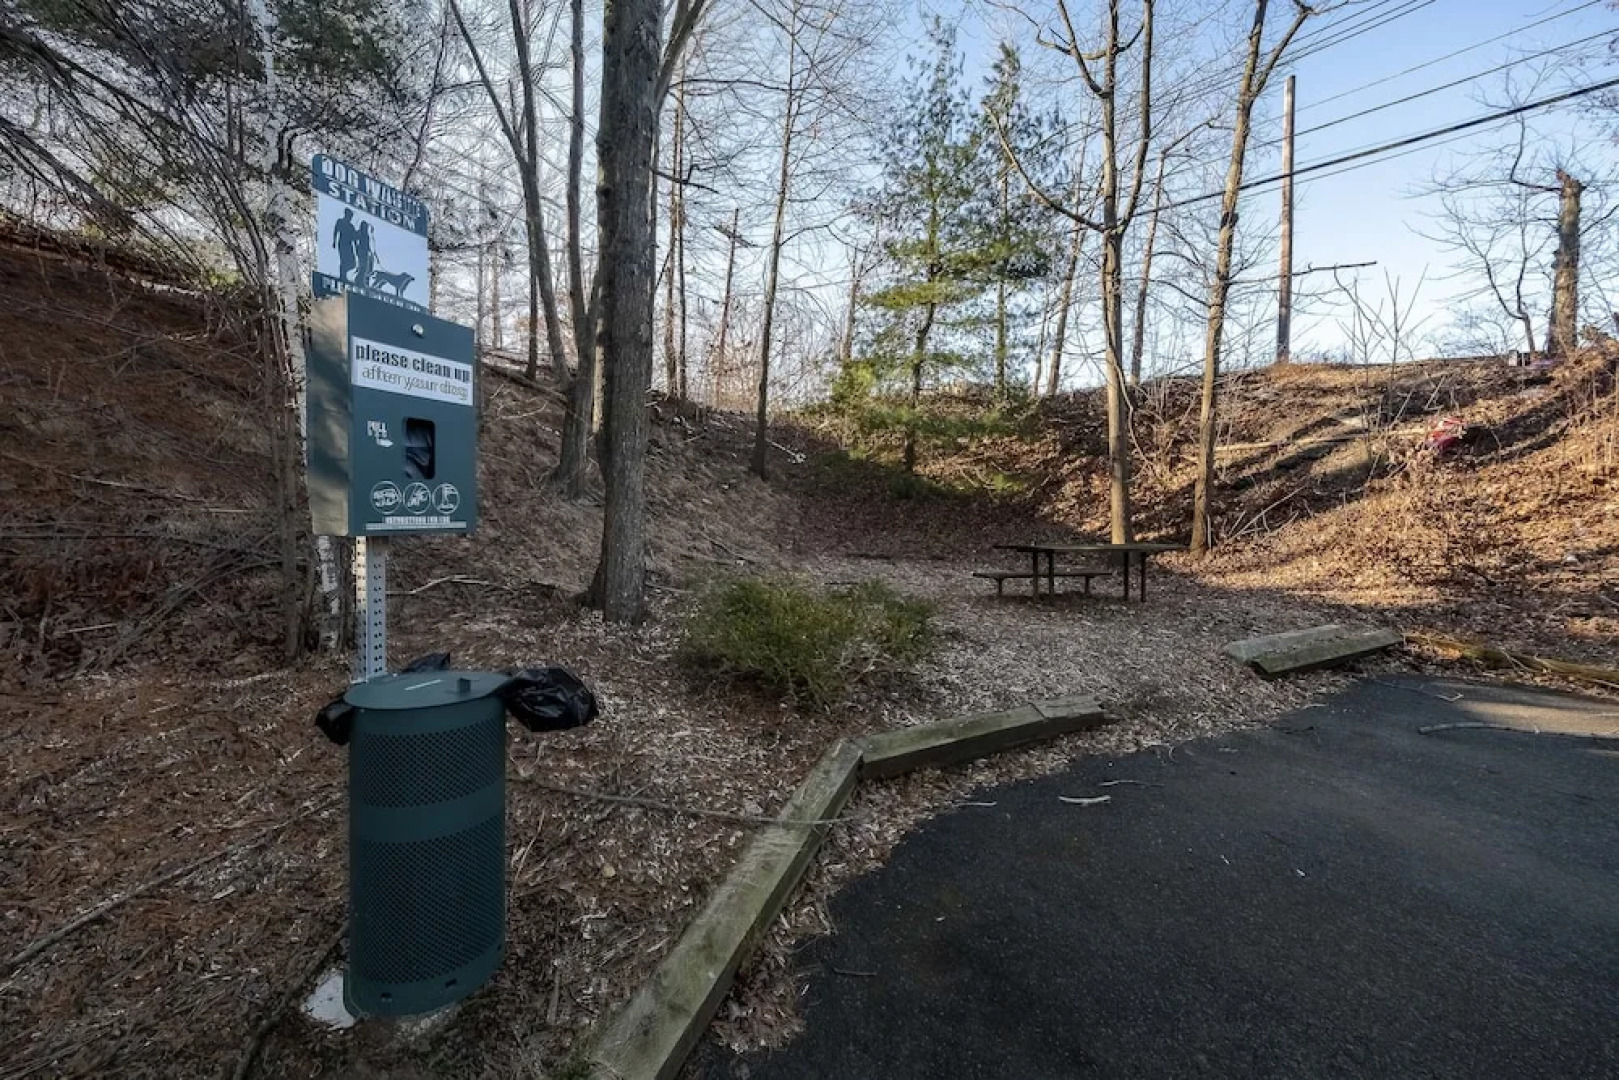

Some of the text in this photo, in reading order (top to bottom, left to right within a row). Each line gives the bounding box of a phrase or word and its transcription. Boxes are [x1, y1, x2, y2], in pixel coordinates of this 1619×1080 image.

[328, 181, 416, 230] STATION
[355, 344, 470, 383] please clean up
